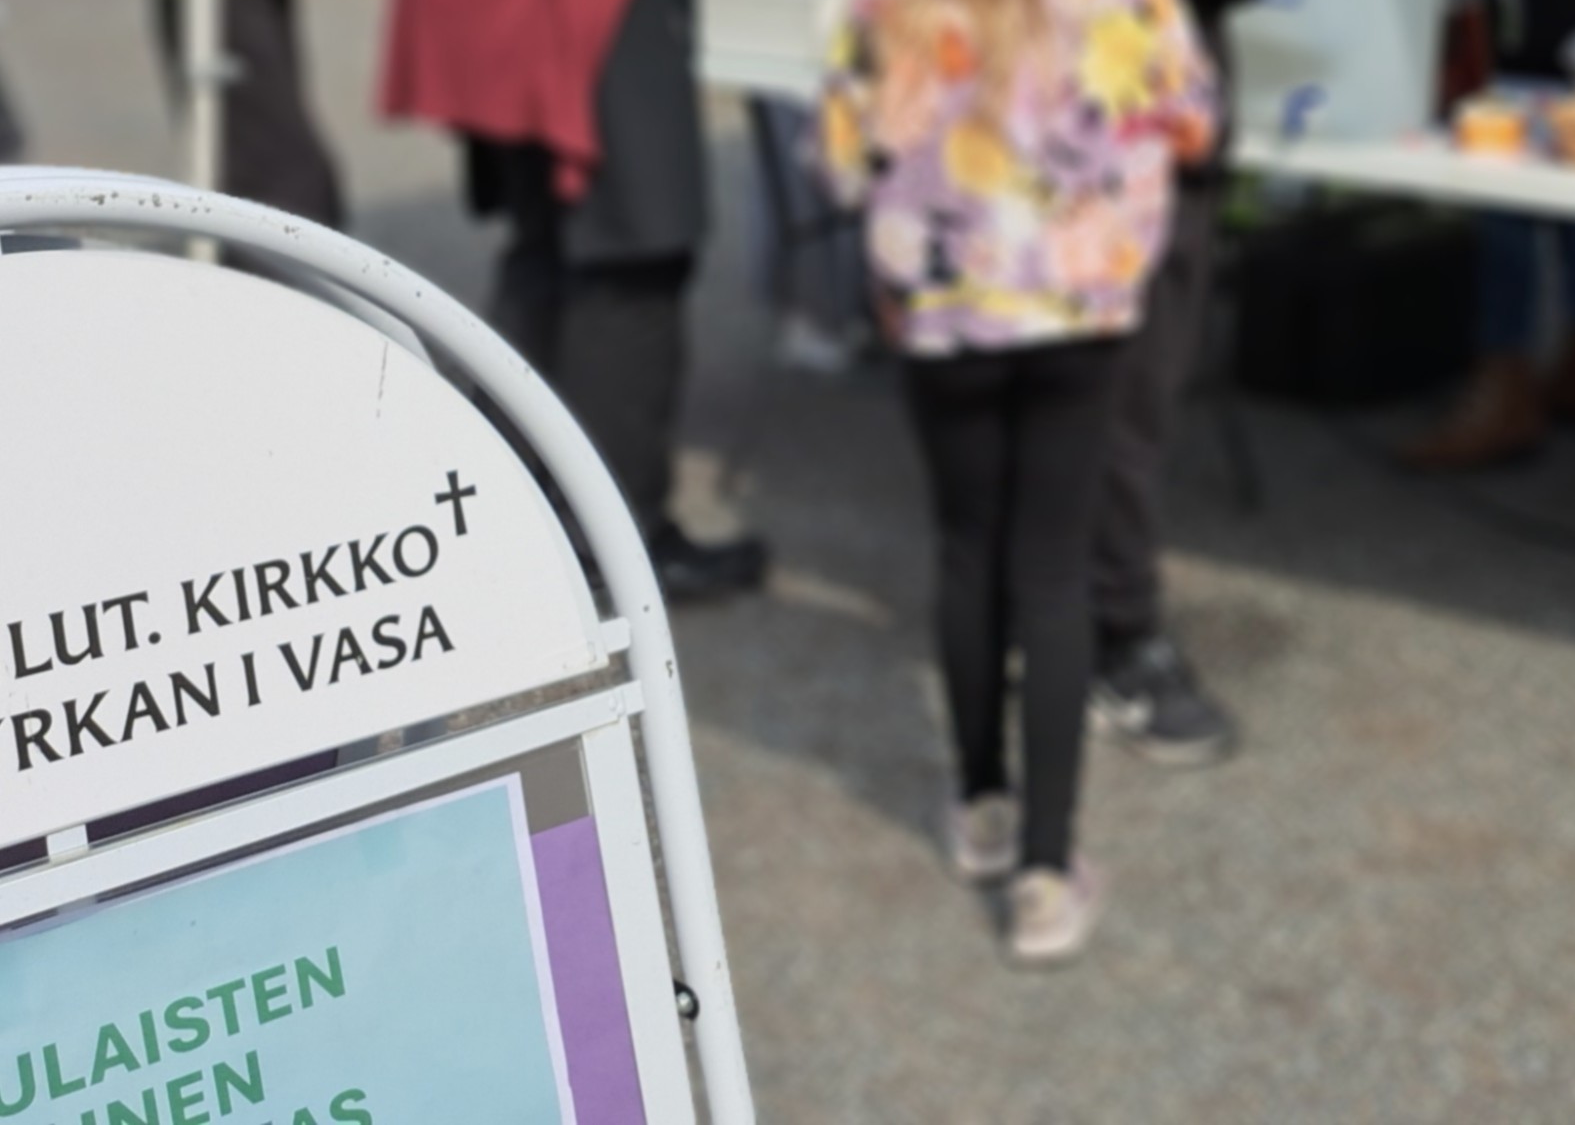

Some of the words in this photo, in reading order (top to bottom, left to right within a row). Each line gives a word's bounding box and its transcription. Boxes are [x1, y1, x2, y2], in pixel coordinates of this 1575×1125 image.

[7, 590, 161, 679] LUT.
[182, 525, 439, 635] KIRKKO
[0, 662, 220, 772] RKAN
[241, 651, 262, 707] I
[277, 605, 456, 691] VASA
[0, 946, 346, 1117] ULAISTEN
